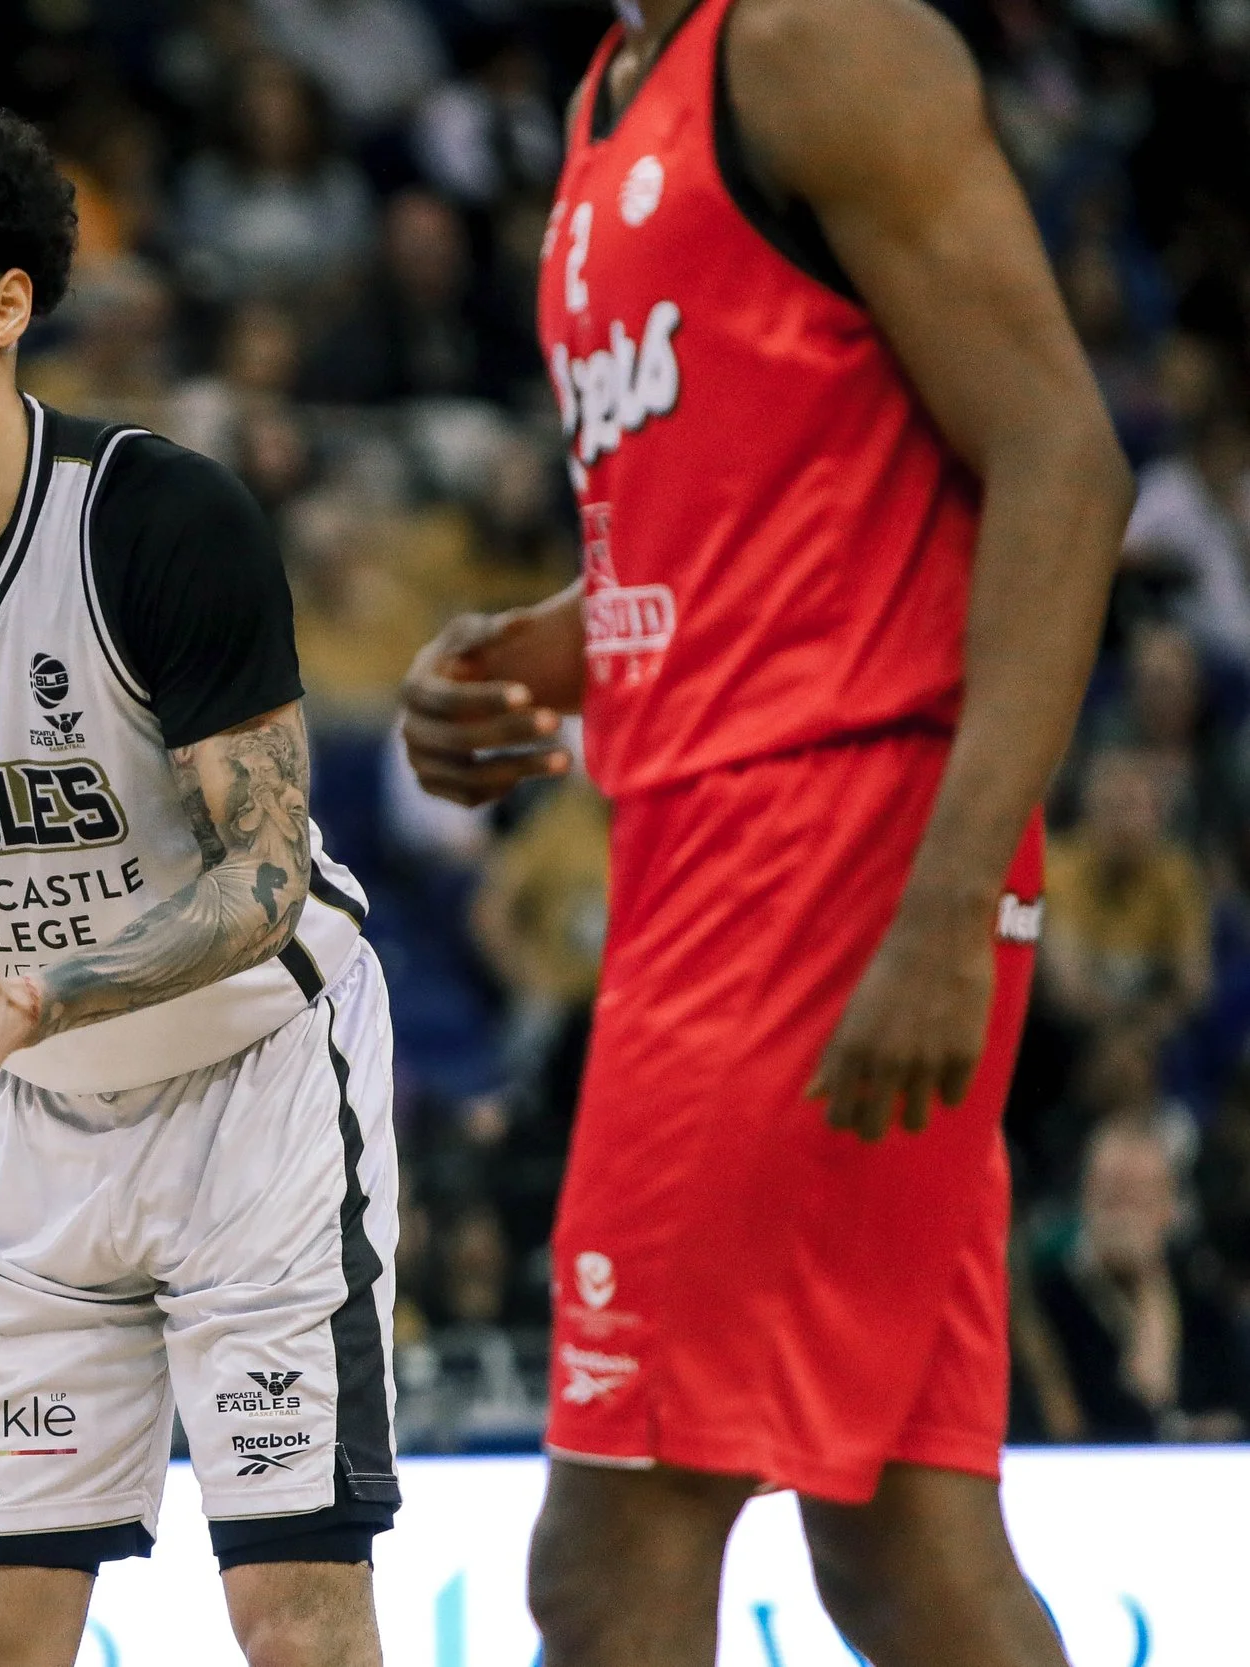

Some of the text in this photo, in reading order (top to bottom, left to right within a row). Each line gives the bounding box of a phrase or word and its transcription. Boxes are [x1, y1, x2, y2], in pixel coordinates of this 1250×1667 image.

[30, 733, 85, 747] EAGLES
[50, 1393, 66, 1402] LLP
[216, 1391, 262, 1400] NEWCASTLE
[217, 1397, 300, 1413] EAGLES
[232, 1432, 310, 1453] Reebok
